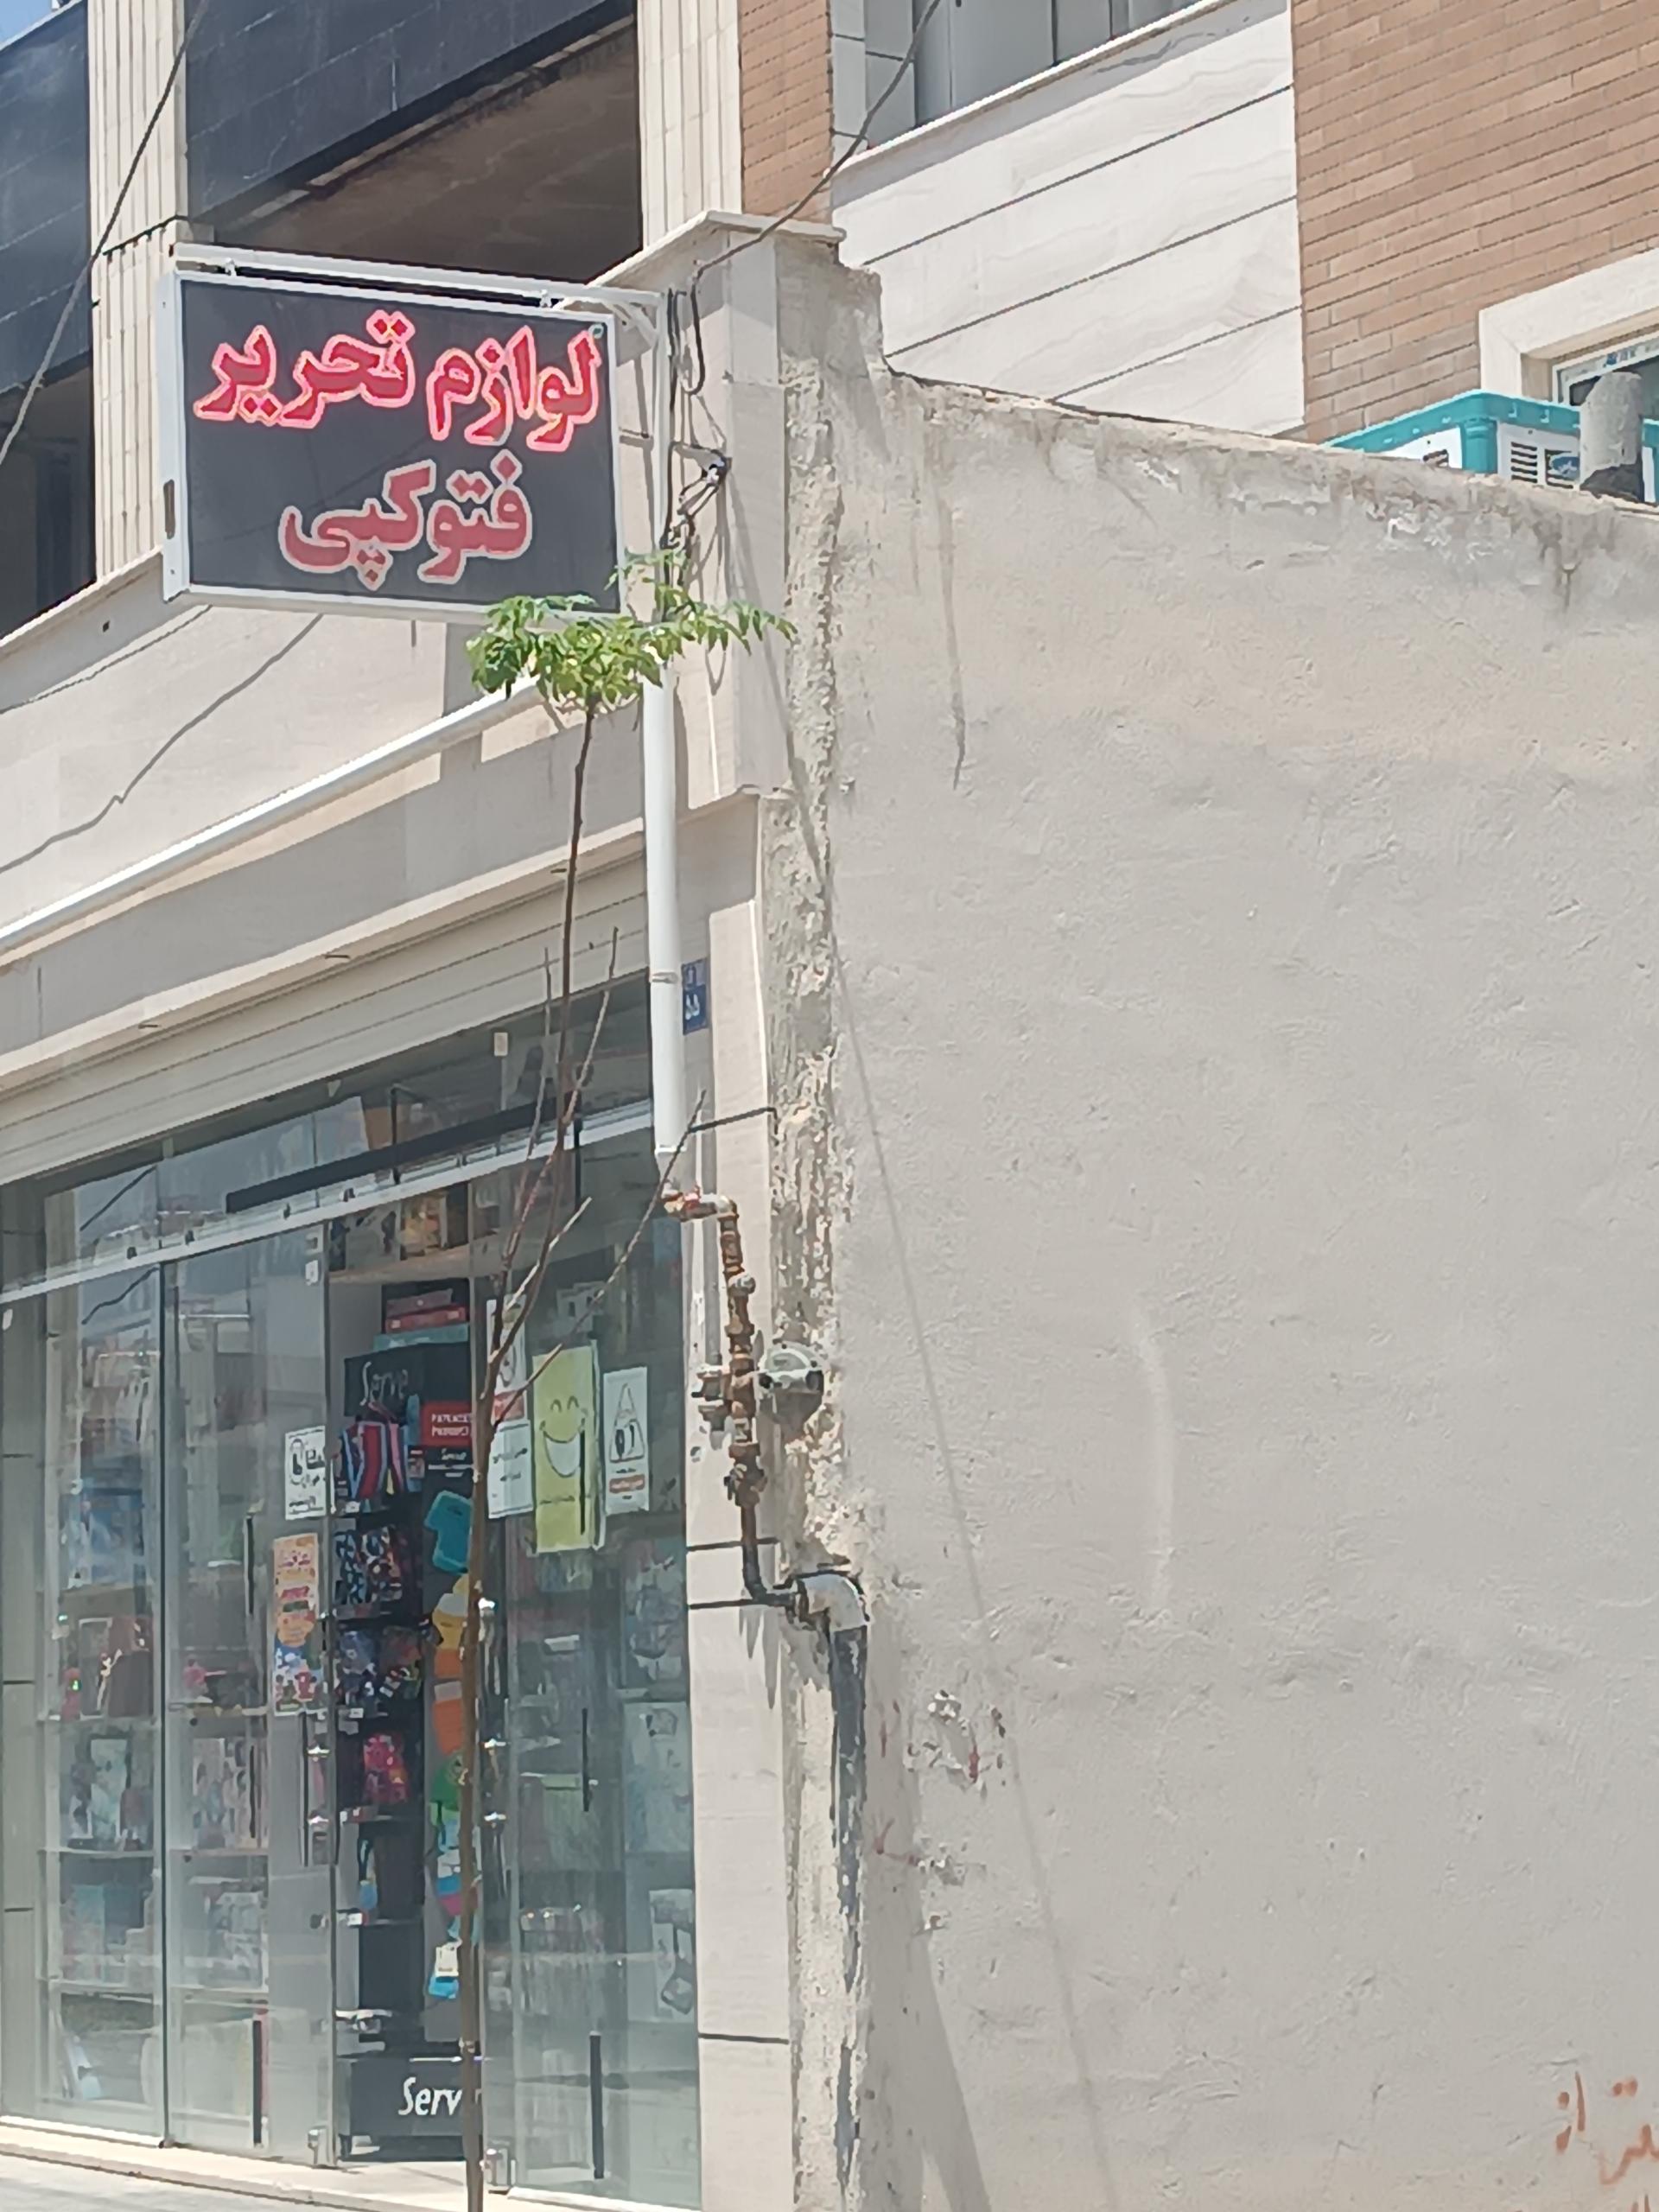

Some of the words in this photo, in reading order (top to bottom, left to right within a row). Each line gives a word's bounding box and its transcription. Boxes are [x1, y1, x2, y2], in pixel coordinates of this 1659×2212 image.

[194, 310, 415, 429] تحریر
[426, 326, 602, 451] لوازم
[279, 449, 532, 590] فتوکپی
[398, 2076, 463, 2116] Serv
